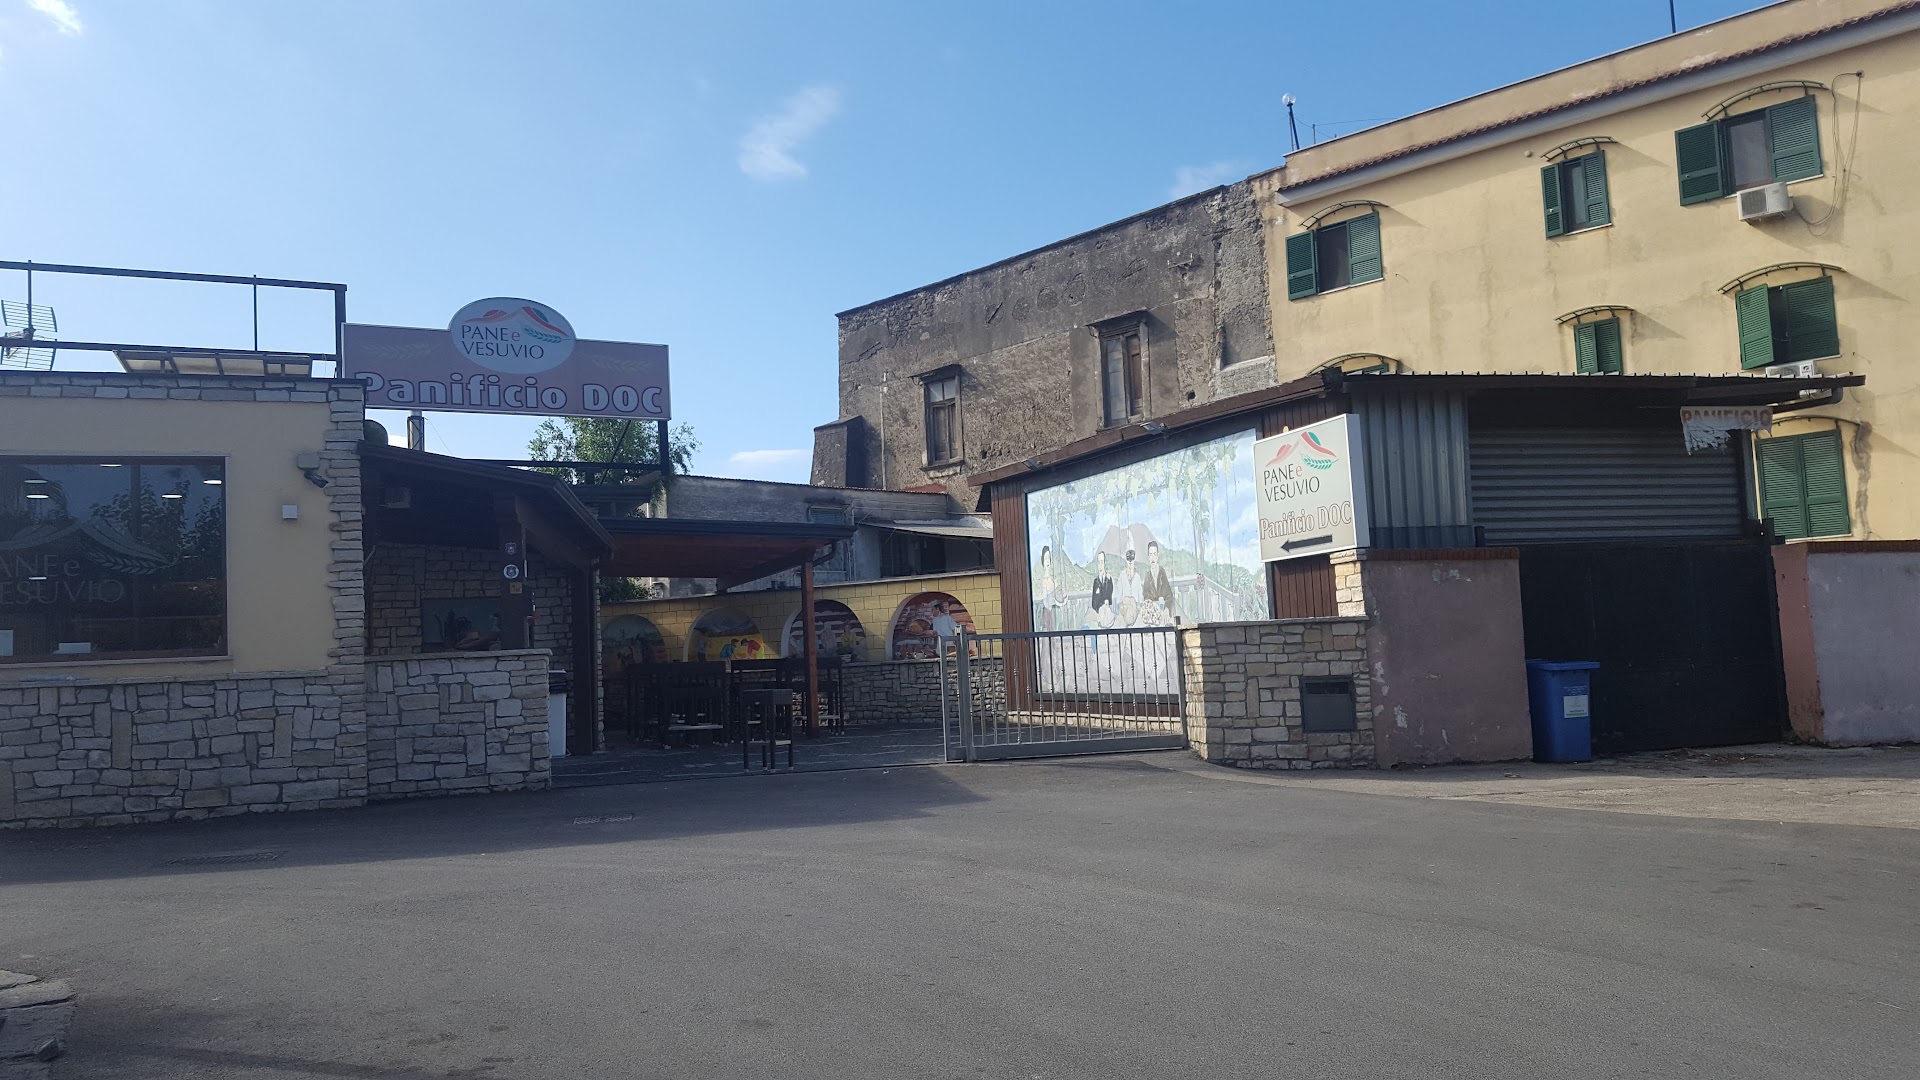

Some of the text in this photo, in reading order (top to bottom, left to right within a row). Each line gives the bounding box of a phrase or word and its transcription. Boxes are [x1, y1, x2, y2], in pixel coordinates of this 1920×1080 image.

[462, 341, 545, 360] VESUVIO
[355, 371, 664, 414] Panificio DOC
[1264, 476, 1320, 503] VESUVIO
[1260, 501, 1352, 540] Panificio DOC
[0, 579, 125, 605] ESUVIO
